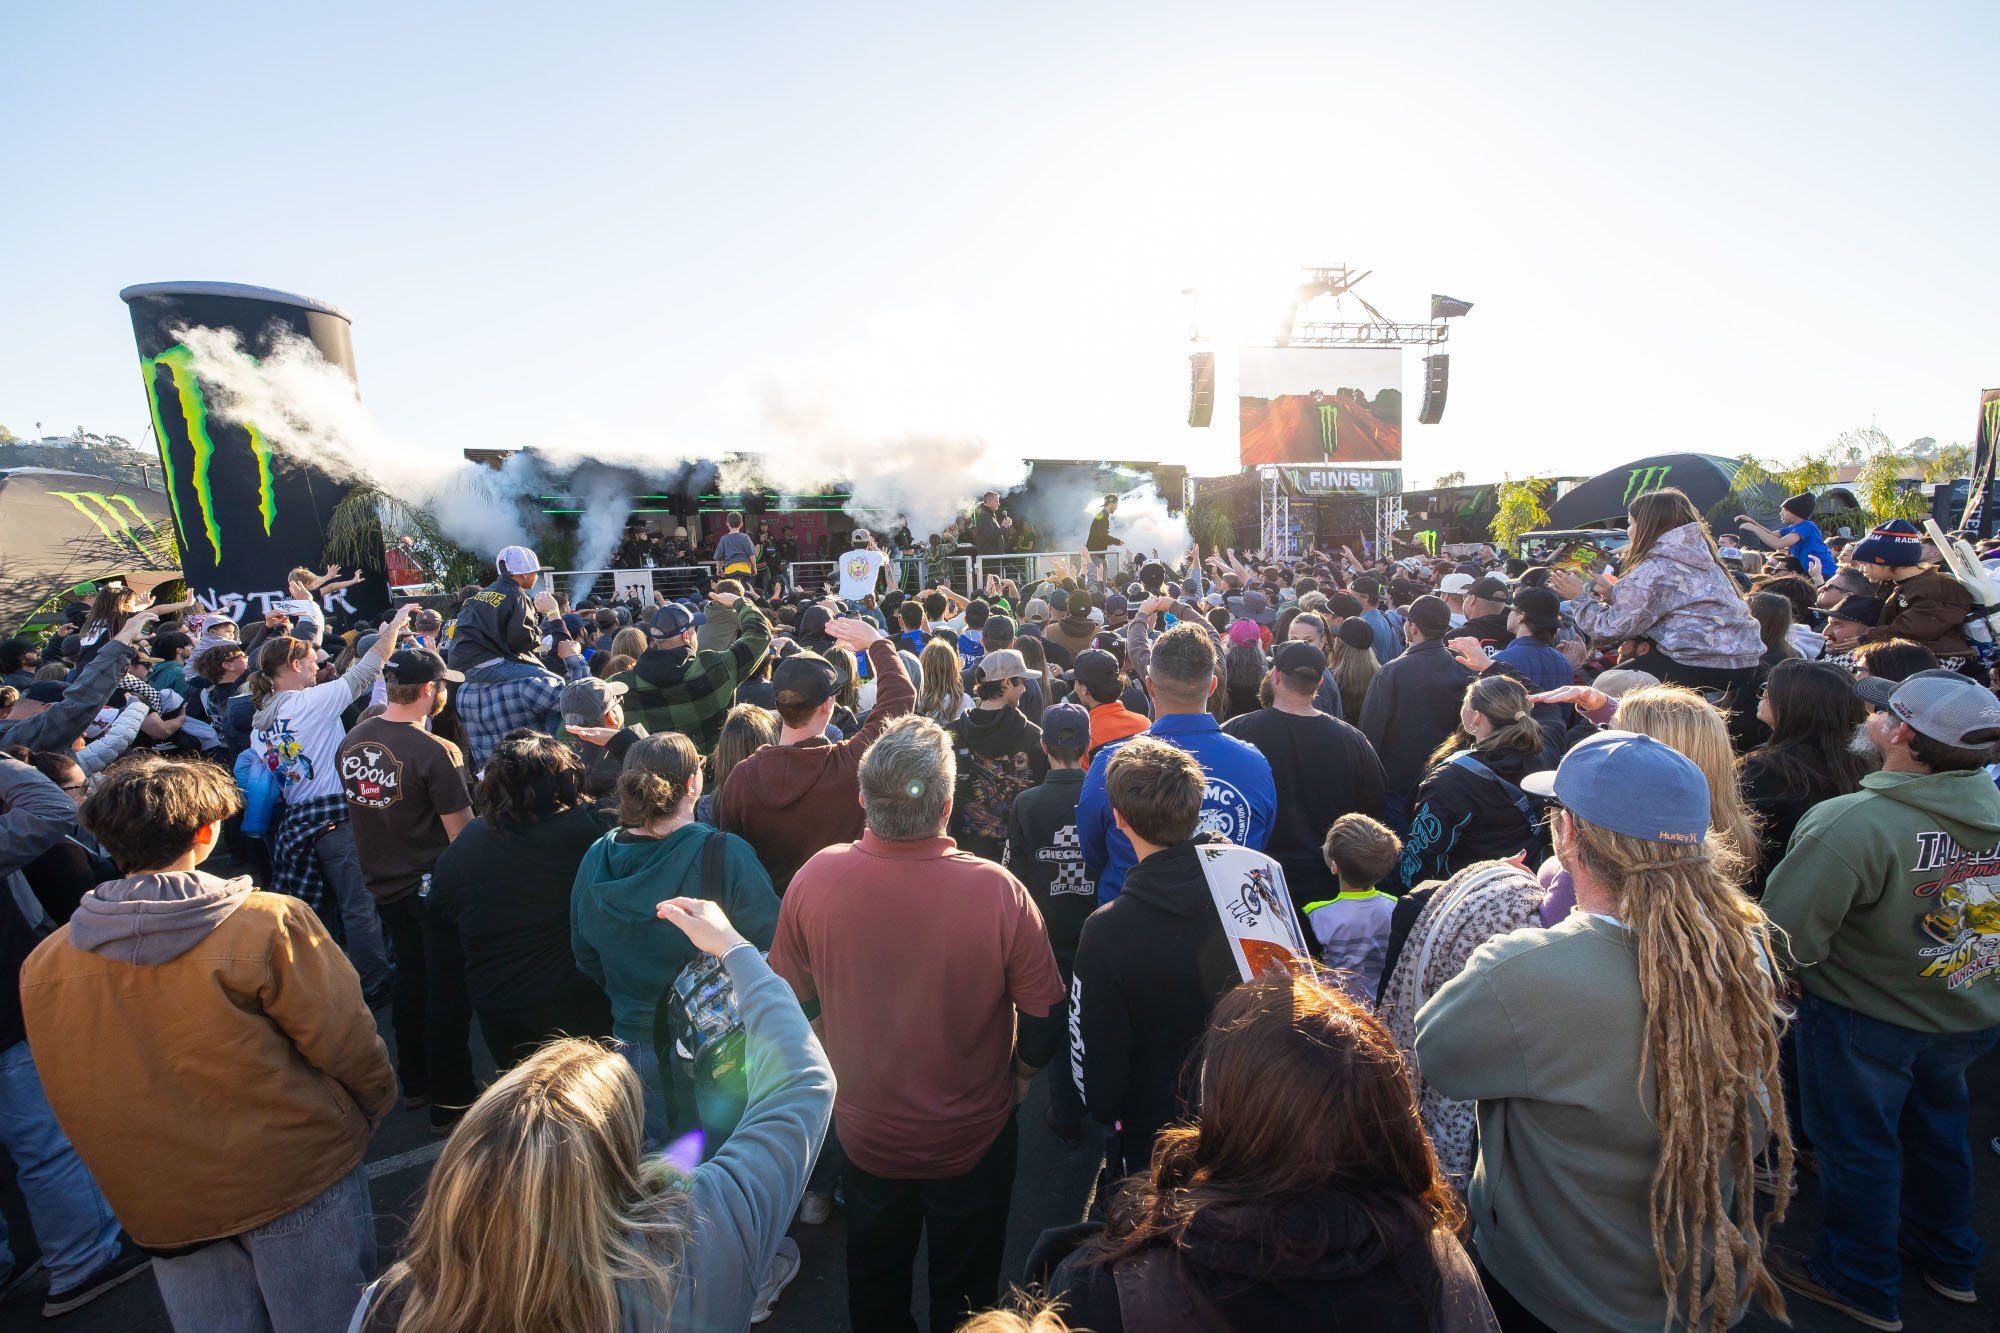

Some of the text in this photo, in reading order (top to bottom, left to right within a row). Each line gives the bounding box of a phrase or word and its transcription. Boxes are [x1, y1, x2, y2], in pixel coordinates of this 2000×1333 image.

[1309, 471, 1374, 487] FINISH
[342, 756, 397, 788] Coors
[1203, 784, 1235, 806] MC
[1235, 803, 1246, 842] CHAMPIONS
[1659, 831, 1690, 843] Hurley
[1052, 883, 1092, 893] OFF ROAD
[1919, 936, 1979, 977] FAST
